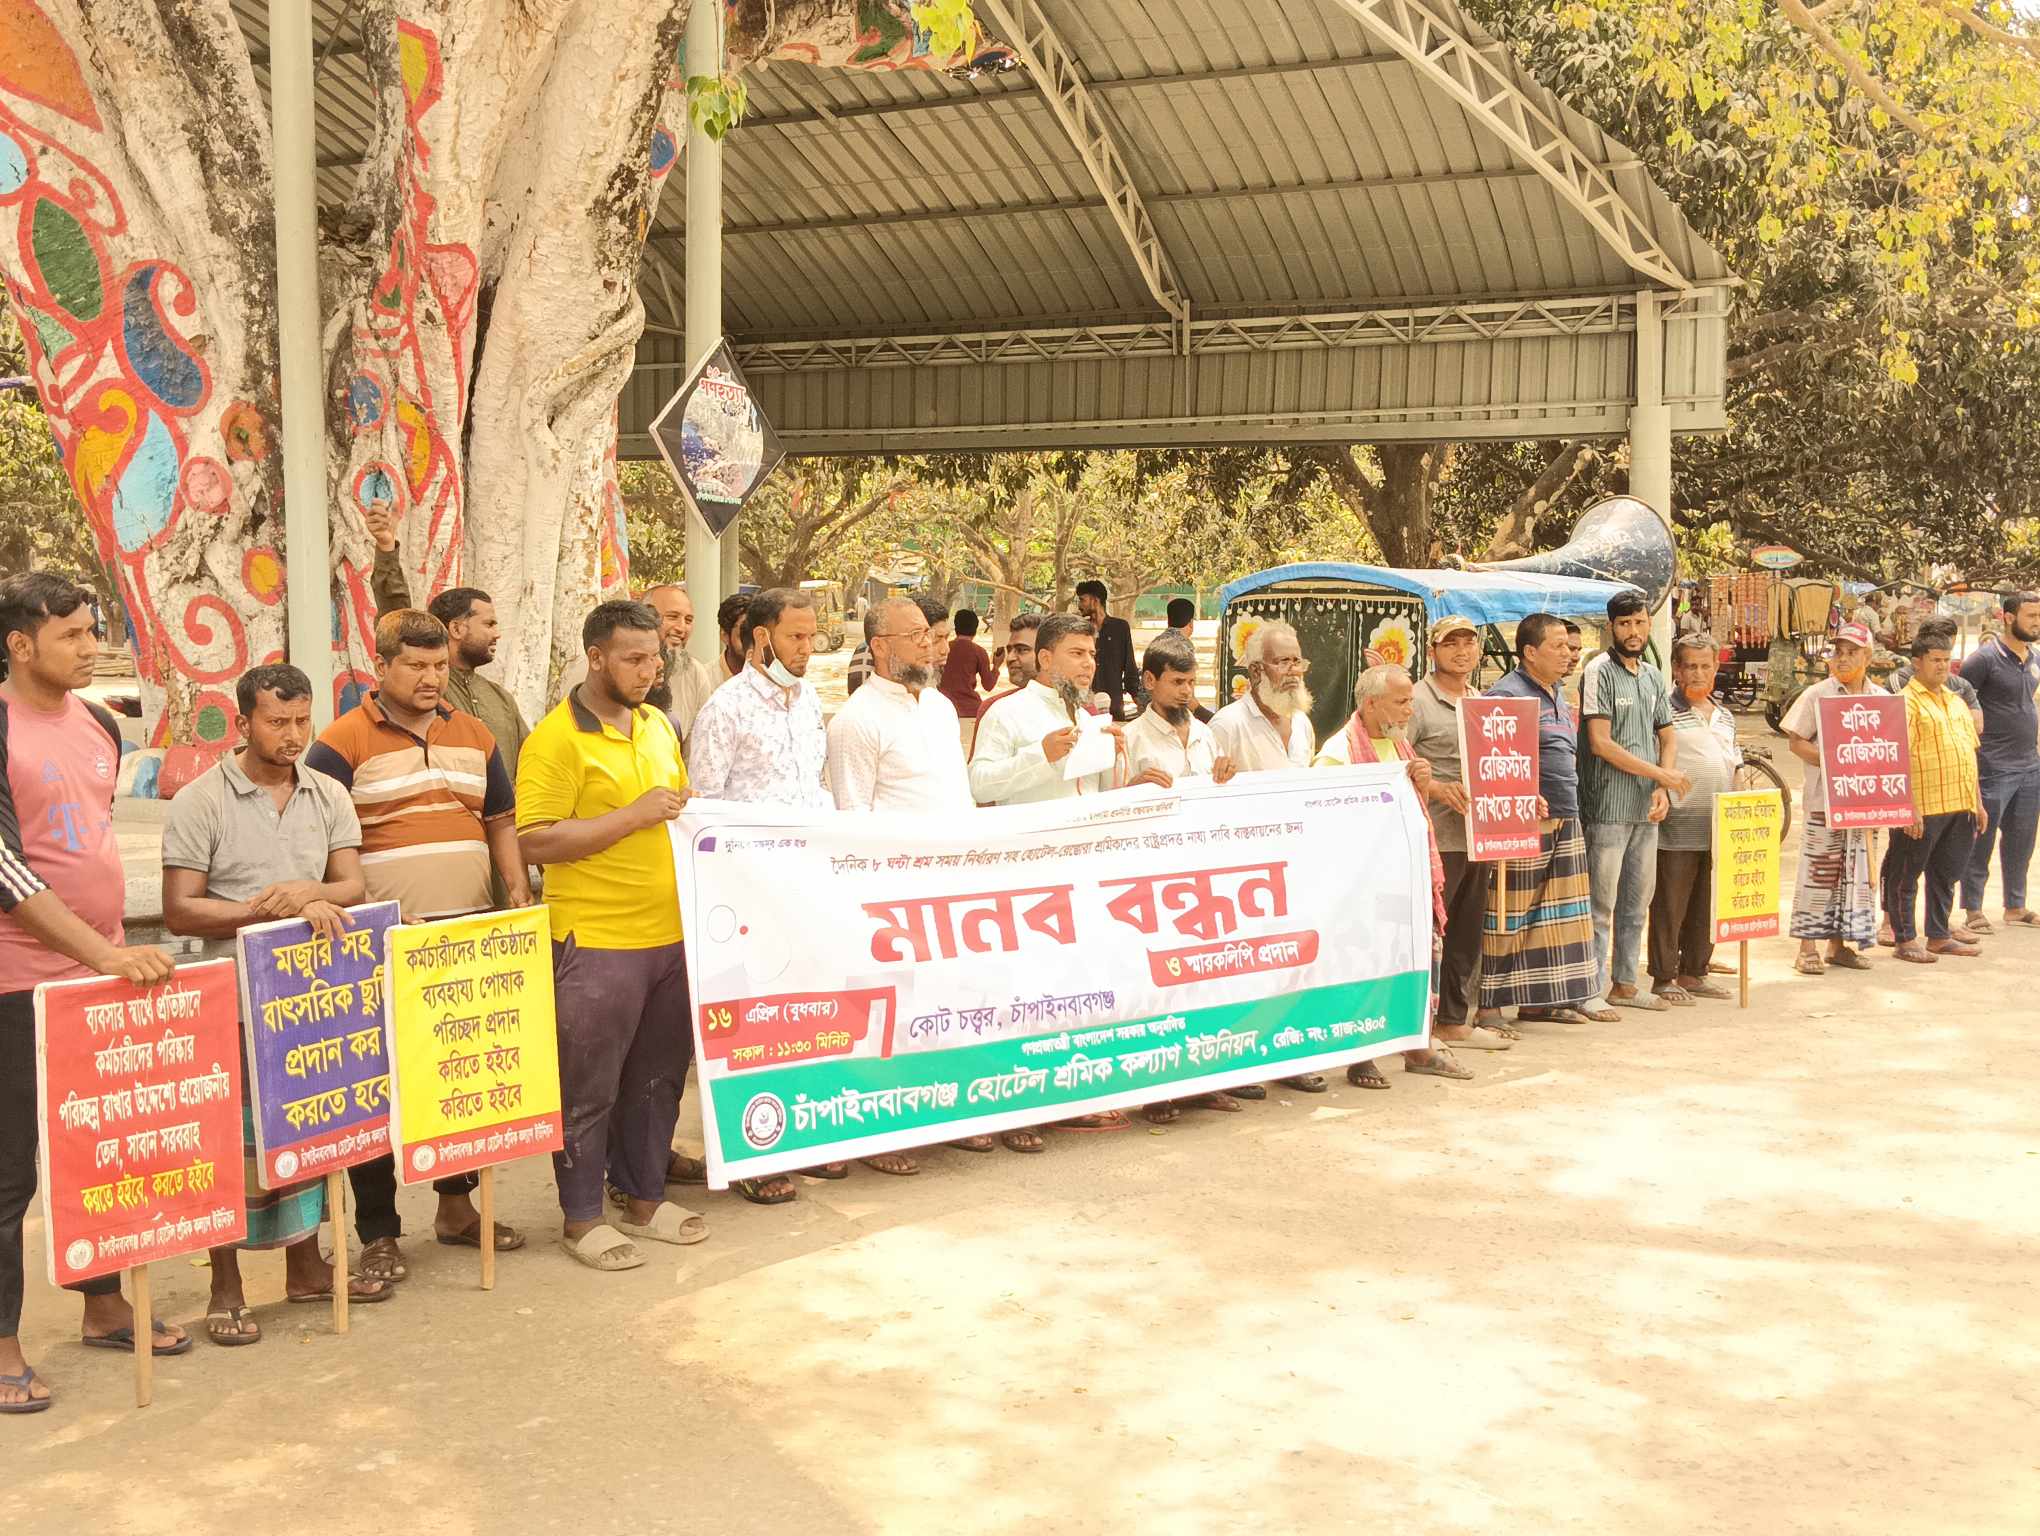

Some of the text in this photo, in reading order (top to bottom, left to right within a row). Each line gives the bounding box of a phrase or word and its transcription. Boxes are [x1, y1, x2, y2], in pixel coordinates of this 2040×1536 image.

[1482, 706, 1518, 742] শ্রমিক
[1841, 703, 1880, 732] শ্রমিক
[1479, 747, 1531, 781] রেজিস্টার
[1837, 736, 1898, 764] রেজিস্টার
[1832, 774, 1907, 798] রাখতে হবে
[1475, 793, 1537, 824] রাখতে হবে
[860, 861, 1289, 963] মানব বন্ধন
[272, 928, 376, 978] মজুরি সহ
[404, 923, 538, 974] কর্মচারীদের প্রতিষ্ঠানে
[1165, 941, 1300, 977] ও স্মারকলিপি প্রদান
[479, 968, 525, 999] পোষাক
[84, 981, 201, 1035] ব্যবসার স্বার্থে প্রতিষ্ঠানে
[261, 978, 354, 1033] বাৎসরিক
[707, 998, 839, 1032] ১৬ এপ্রিল (বুধবার)
[1009, 989, 1116, 1024] চাঁপাইনবাবগঞ্জ
[433, 1008, 521, 1046] পরিচ্ছদ প্রদান
[732, 1042, 765, 1063] সকাল
[777, 1040, 812, 1058] ১১:৩০
[815, 1030, 852, 1051] মিনিট
[94, 1035, 154, 1079] কর্মচারীদের
[285, 1037, 344, 1079] প্রদান
[438, 1042, 520, 1083] করিতে হইবে
[58, 1062, 231, 1131] পরিচ্ছন্ন রাখার উদ্দেশ্যে প্রয়োজনীয়
[439, 1079, 523, 1121] করিতে হইবে
[790, 1080, 959, 1132] চাঁপাইনবাবগঞ্জ
[967, 1064, 1050, 1104] হোটেল
[1052, 1052, 1114, 1090] শ্রমিক
[1116, 1042, 1182, 1078] কল্যাণ
[282, 1086, 348, 1131] করতে
[95, 1121, 202, 1171] তেল, সাবান সরবরাহ
[80, 1157, 215, 1215] করতে হইবে, করতে হইবে
